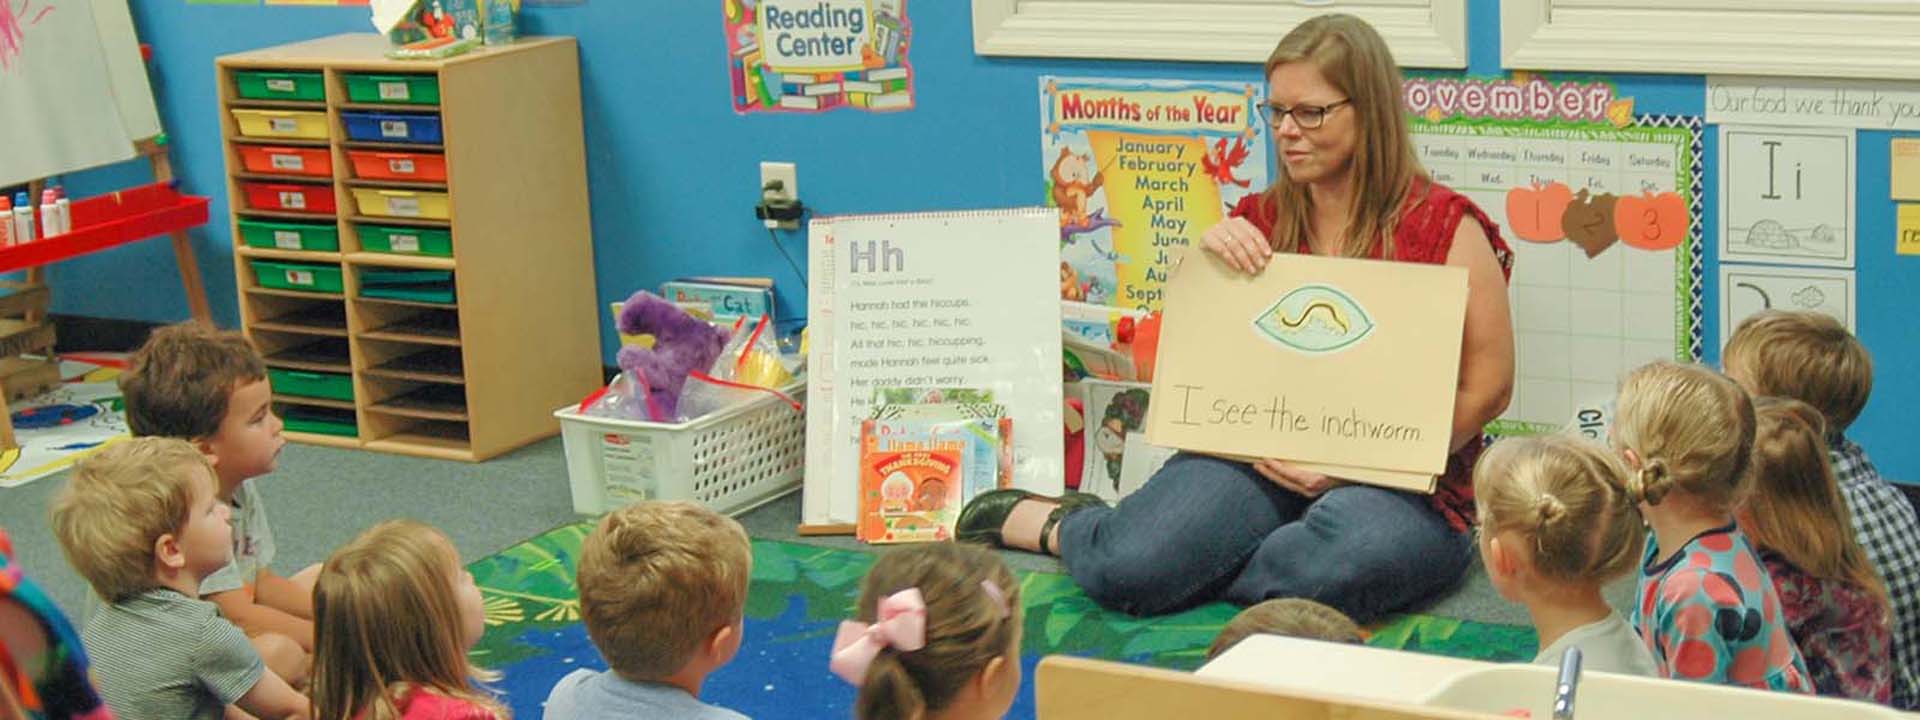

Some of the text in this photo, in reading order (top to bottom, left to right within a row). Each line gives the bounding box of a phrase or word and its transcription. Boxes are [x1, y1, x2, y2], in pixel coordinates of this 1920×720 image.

[765, 5, 864, 33] Reading
[776, 33, 855, 57] Center
[1061, 93, 1242, 124] Months of the Year
[1407, 80, 1607, 115] ovember
[1711, 84, 1748, 113] Our
[1752, 86, 1786, 113] God
[1795, 99, 1824, 115] we
[1832, 87, 1884, 117] thank
[1116, 138, 1185, 158] January
[1423, 144, 1671, 168] Tuesday Wednesday Thursday Friday Saturday
[1119, 155, 1197, 177] February
[1135, 176, 1188, 192] March
[1142, 195, 1184, 214] April
[1150, 216, 1187, 234] May
[1582, 208, 1605, 235] 2
[1643, 209, 1662, 242] 3
[849, 240, 904, 273] Hh
[723, 295, 752, 314] Cat
[850, 300, 889, 311] Hannah
[891, 300, 910, 310] had
[912, 299, 928, 309] the
[866, 339, 884, 348] that
[881, 358, 919, 368] Hannah
[943, 356, 967, 366] quite
[1170, 384, 1204, 425] I
[1208, 398, 1258, 425] see
[1263, 396, 1311, 432] the
